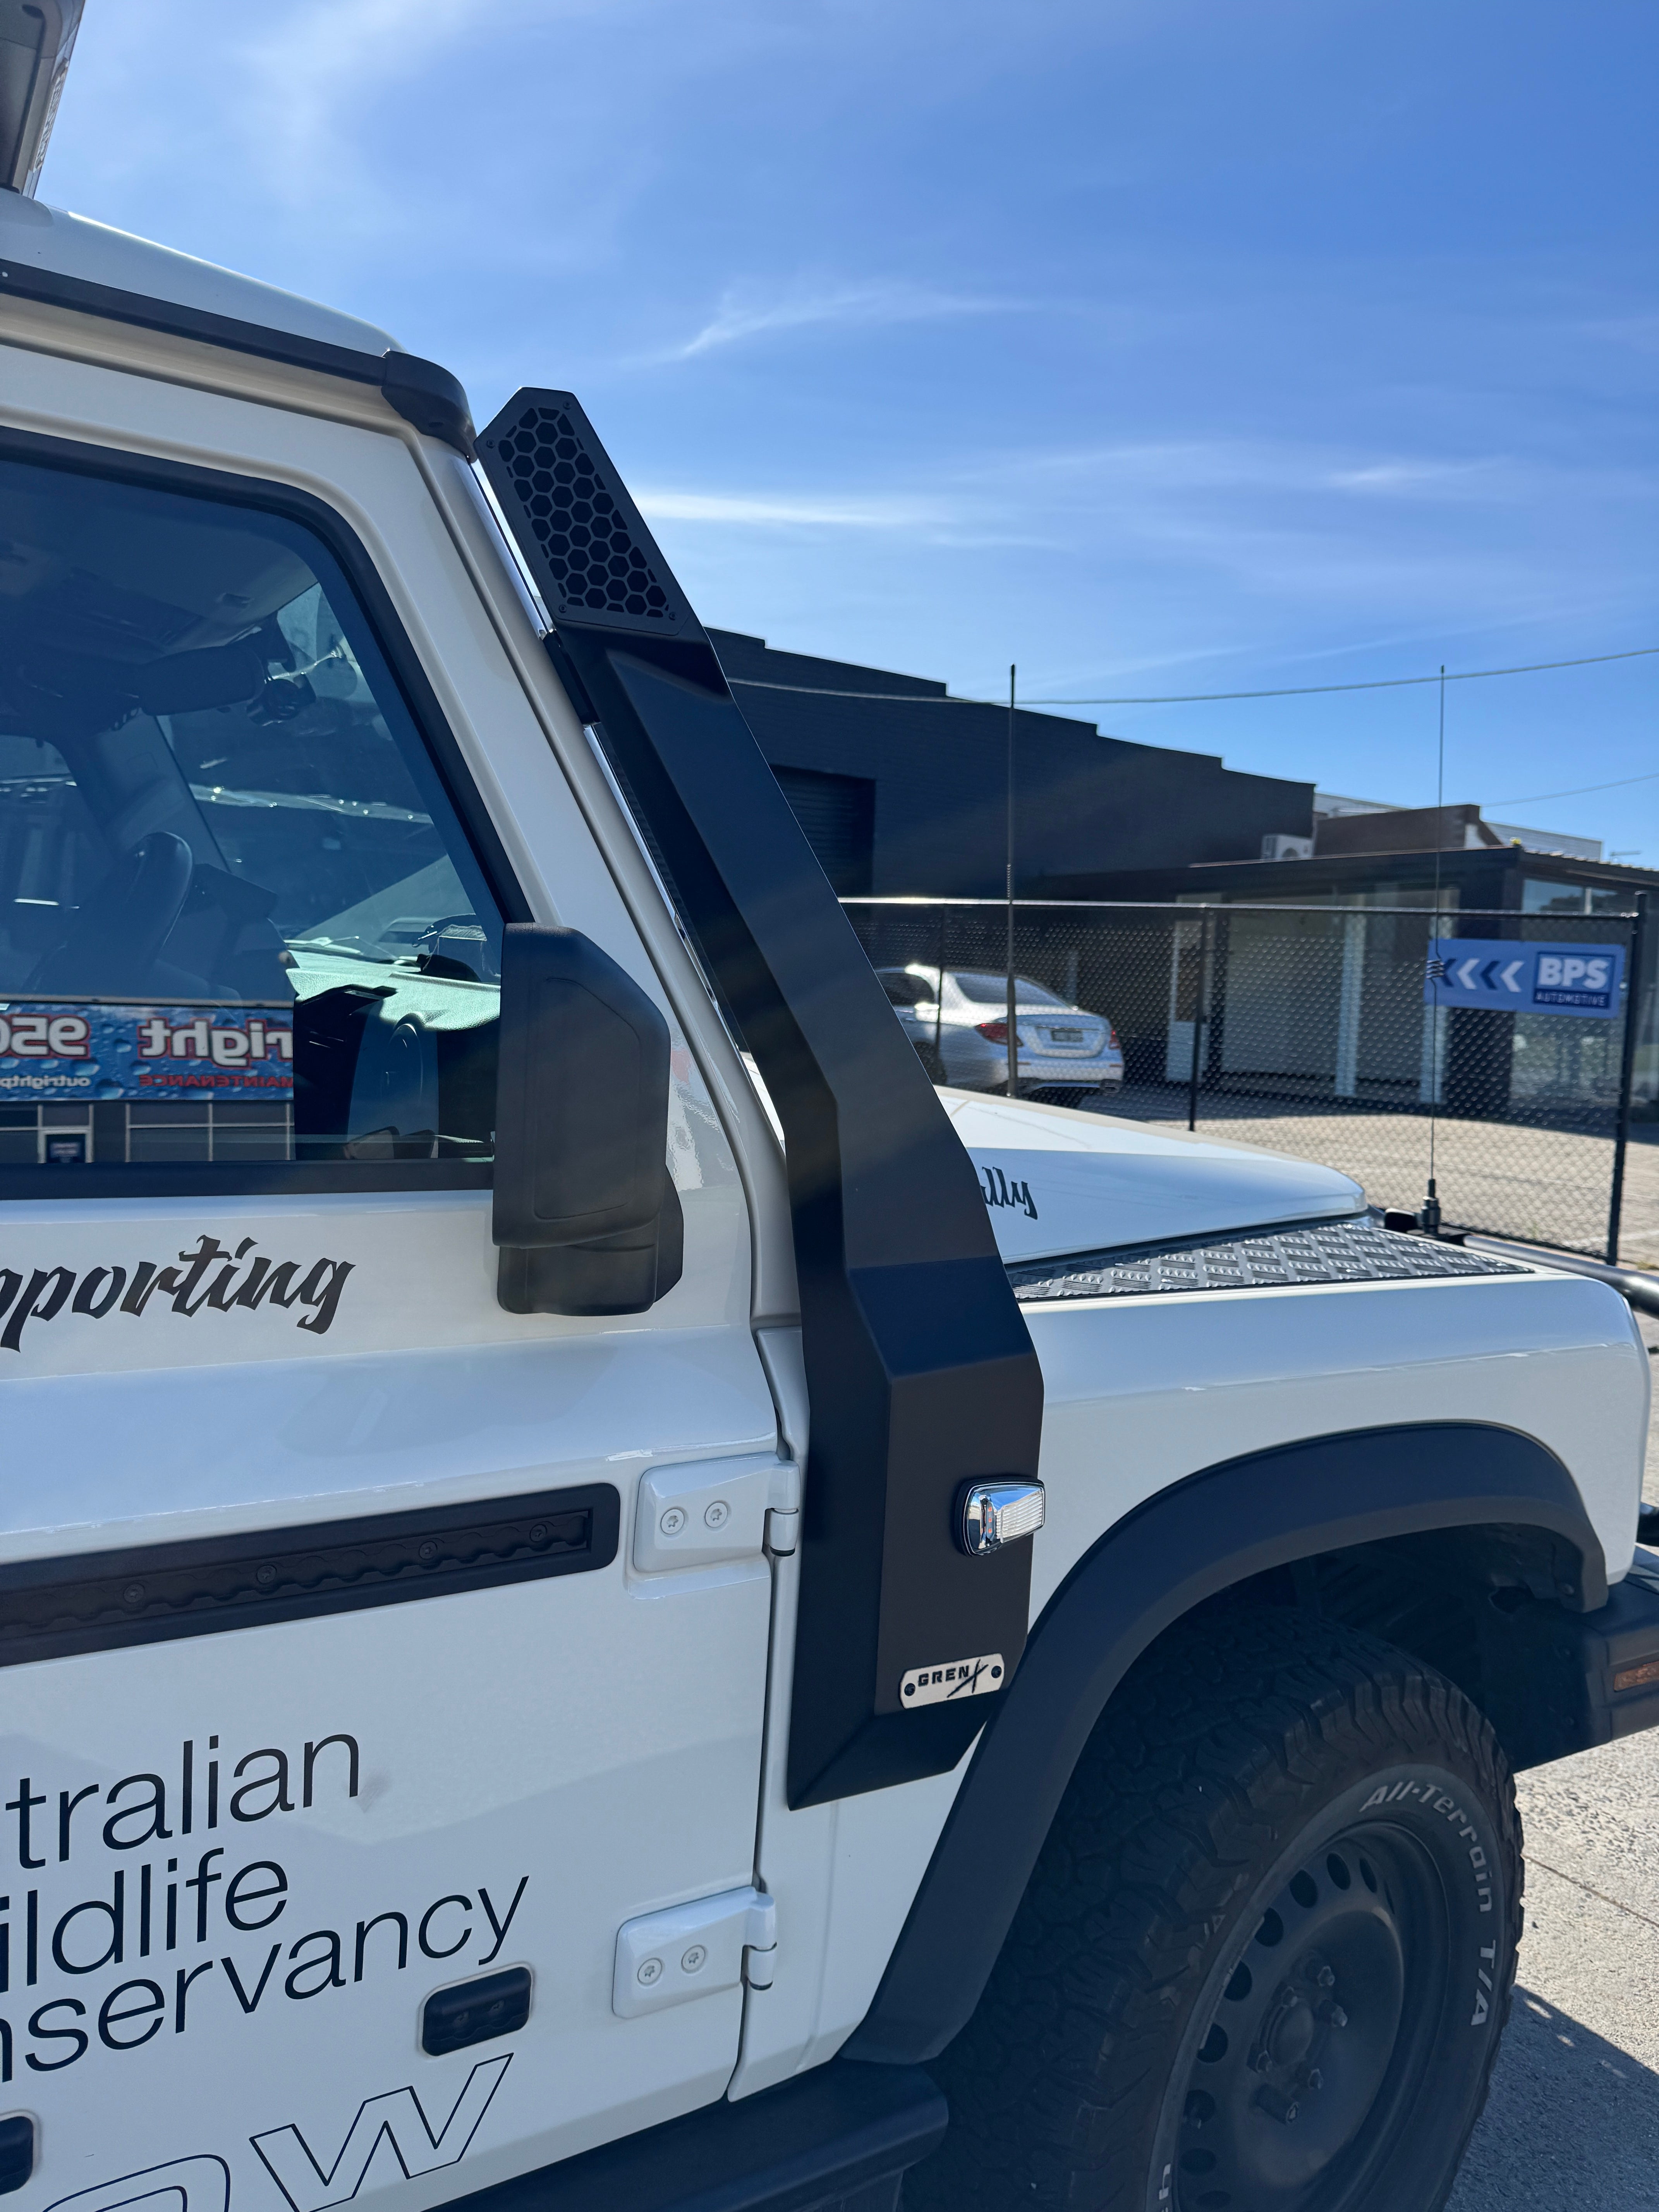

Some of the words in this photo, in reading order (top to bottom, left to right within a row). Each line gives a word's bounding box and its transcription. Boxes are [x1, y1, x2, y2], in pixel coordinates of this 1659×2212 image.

[1536, 991, 1607, 1006] AUTOMOTIVE
[1538, 958, 1609, 989] BPS
[5, 1733, 359, 1869] tralian
[1470, 1939, 1496, 2026] T/A
